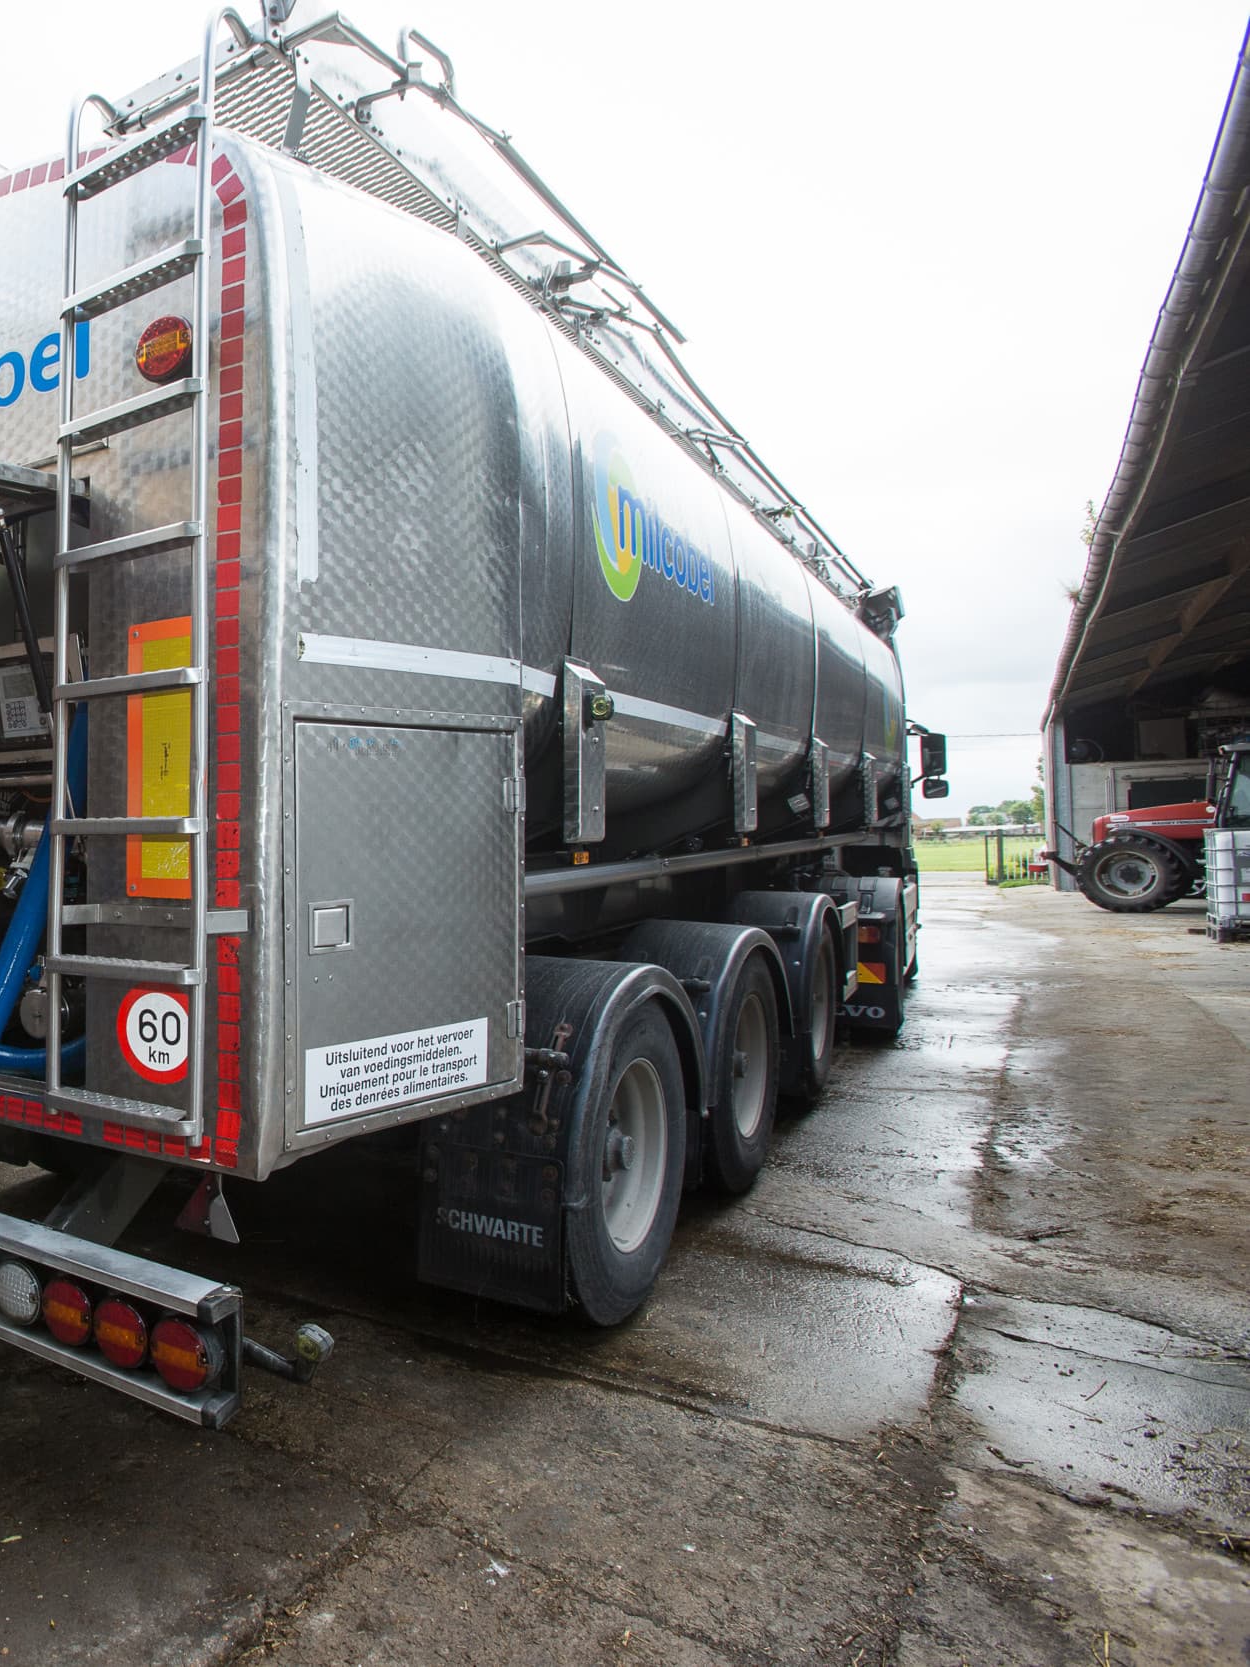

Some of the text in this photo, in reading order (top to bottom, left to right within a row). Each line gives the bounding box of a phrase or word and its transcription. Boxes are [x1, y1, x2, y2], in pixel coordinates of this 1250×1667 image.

[618, 484, 715, 606] milcobel
[138, 1008, 181, 1046] 60
[148, 1046, 170, 1065] km
[325, 1029, 474, 1066] Uitsluitend voor het vervoer
[340, 1045, 462, 1079] van voedingsmiddelen.
[319, 1054, 478, 1098] Uniquement pour le transport
[330, 1072, 468, 1112] des denrées alimentaires.
[435, 1206, 544, 1248] SCHWARTE
